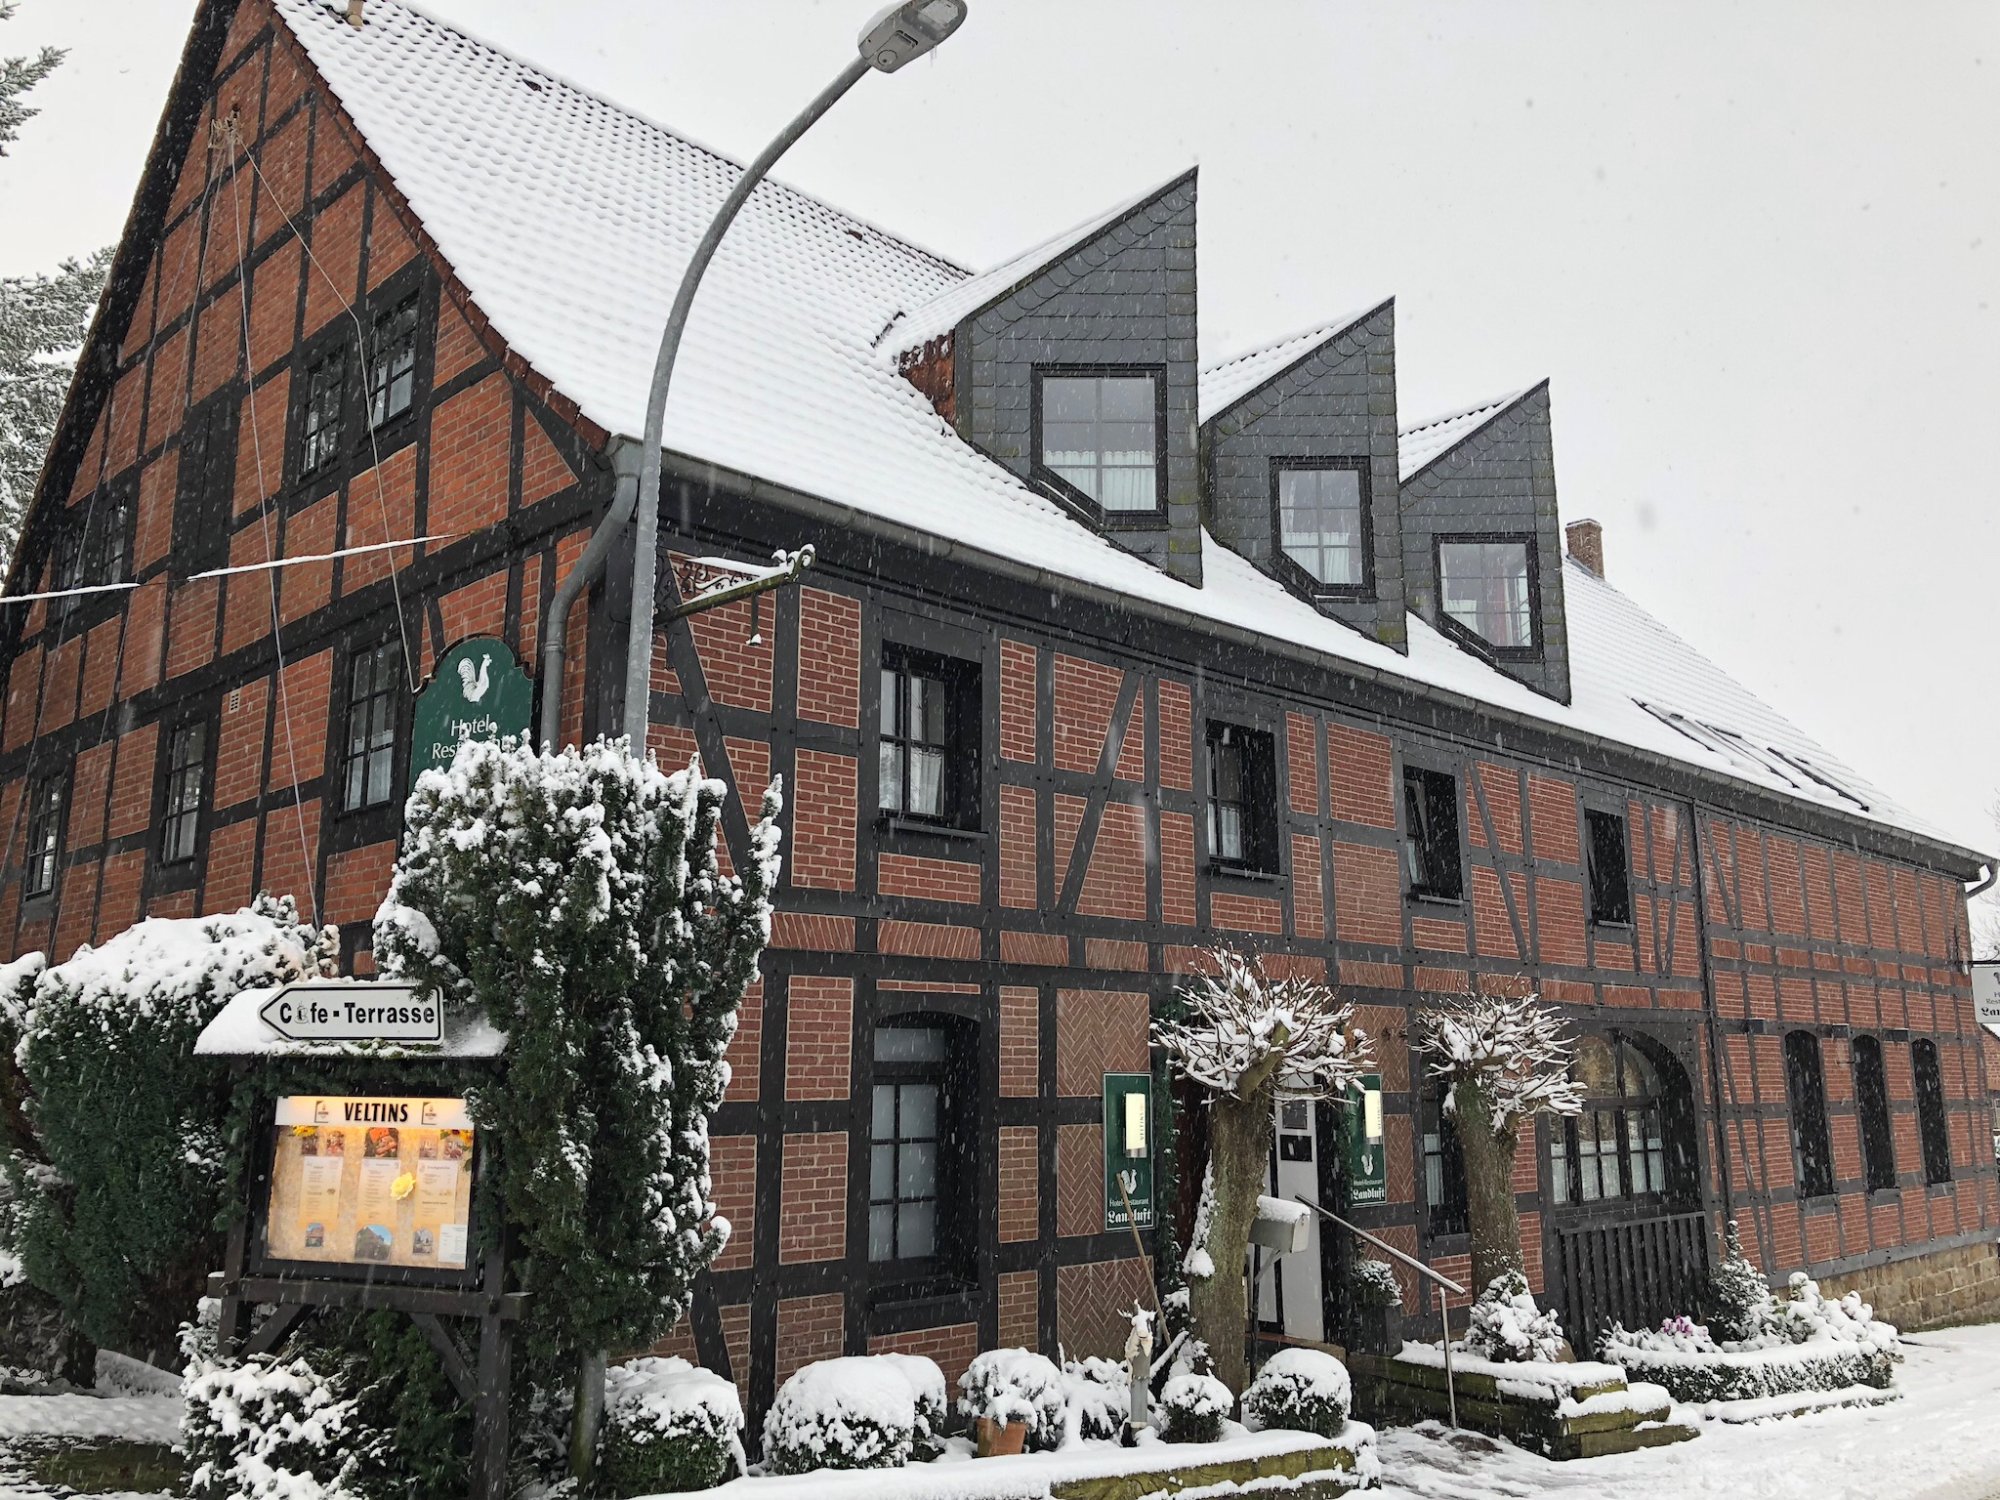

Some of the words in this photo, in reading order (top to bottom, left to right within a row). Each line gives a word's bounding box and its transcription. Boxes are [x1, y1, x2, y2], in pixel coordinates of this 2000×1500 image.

[451, 714, 490, 736] Hotel
[344, 1101, 409, 1123] VELTINS
[1353, 1187, 1384, 1200] Landluft
[1108, 1208, 1151, 1223] Lanluft
